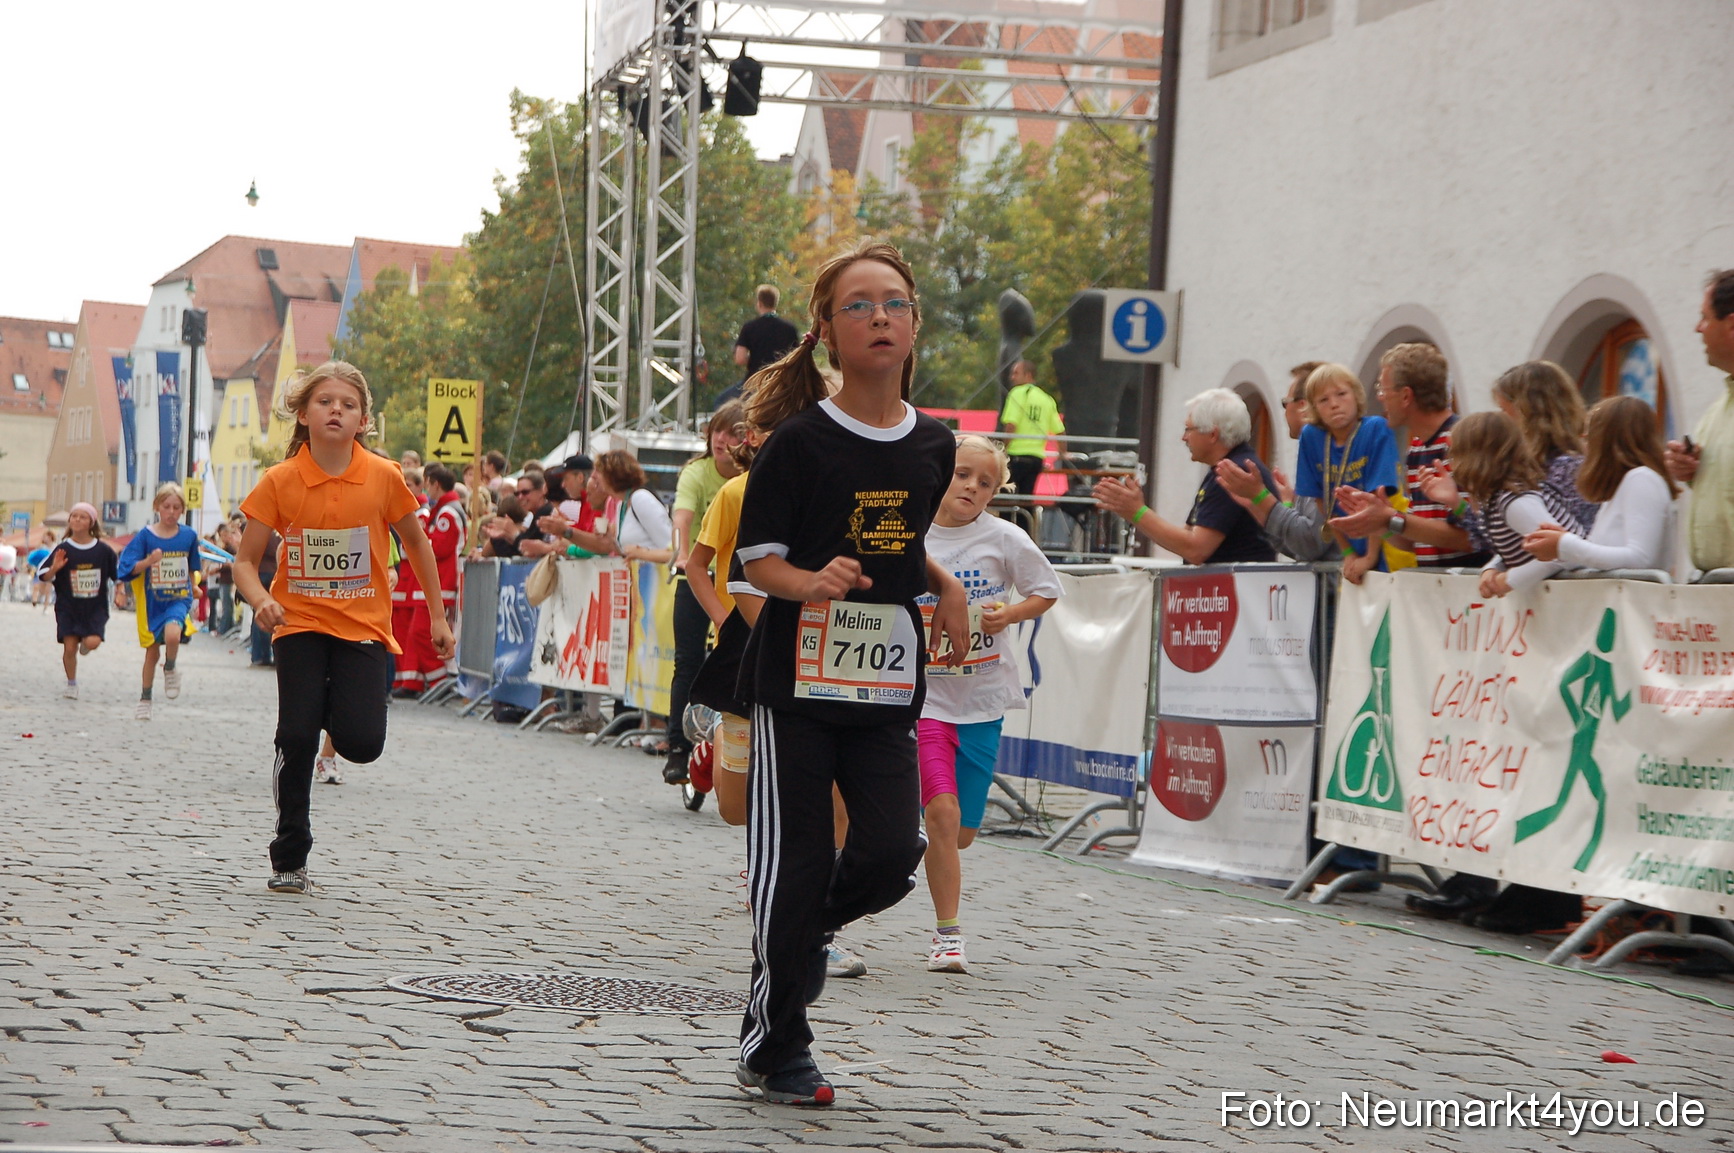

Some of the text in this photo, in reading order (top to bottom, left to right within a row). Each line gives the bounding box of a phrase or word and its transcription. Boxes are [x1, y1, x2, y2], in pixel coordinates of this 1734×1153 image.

[435, 382, 477, 399] Block
[439, 405, 469, 444] A
[188, 488, 199, 502] B
[855, 490, 909, 500] NEUMARKTER
[859, 499, 904, 508] STADTLAUF
[307, 534, 340, 547] Luisa-
[862, 532, 916, 540] BAMBINILAUF
[309, 552, 363, 571] 7067
[162, 569, 187, 579] 7068
[1168, 586, 1229, 614] Wir verkaufen
[834, 609, 882, 631] Melina
[802, 635, 818, 650] K5
[1171, 621, 1222, 653] im Auftrag!
[833, 640, 907, 672] 7102
[870, 688, 912, 699] PFLEIDERER
